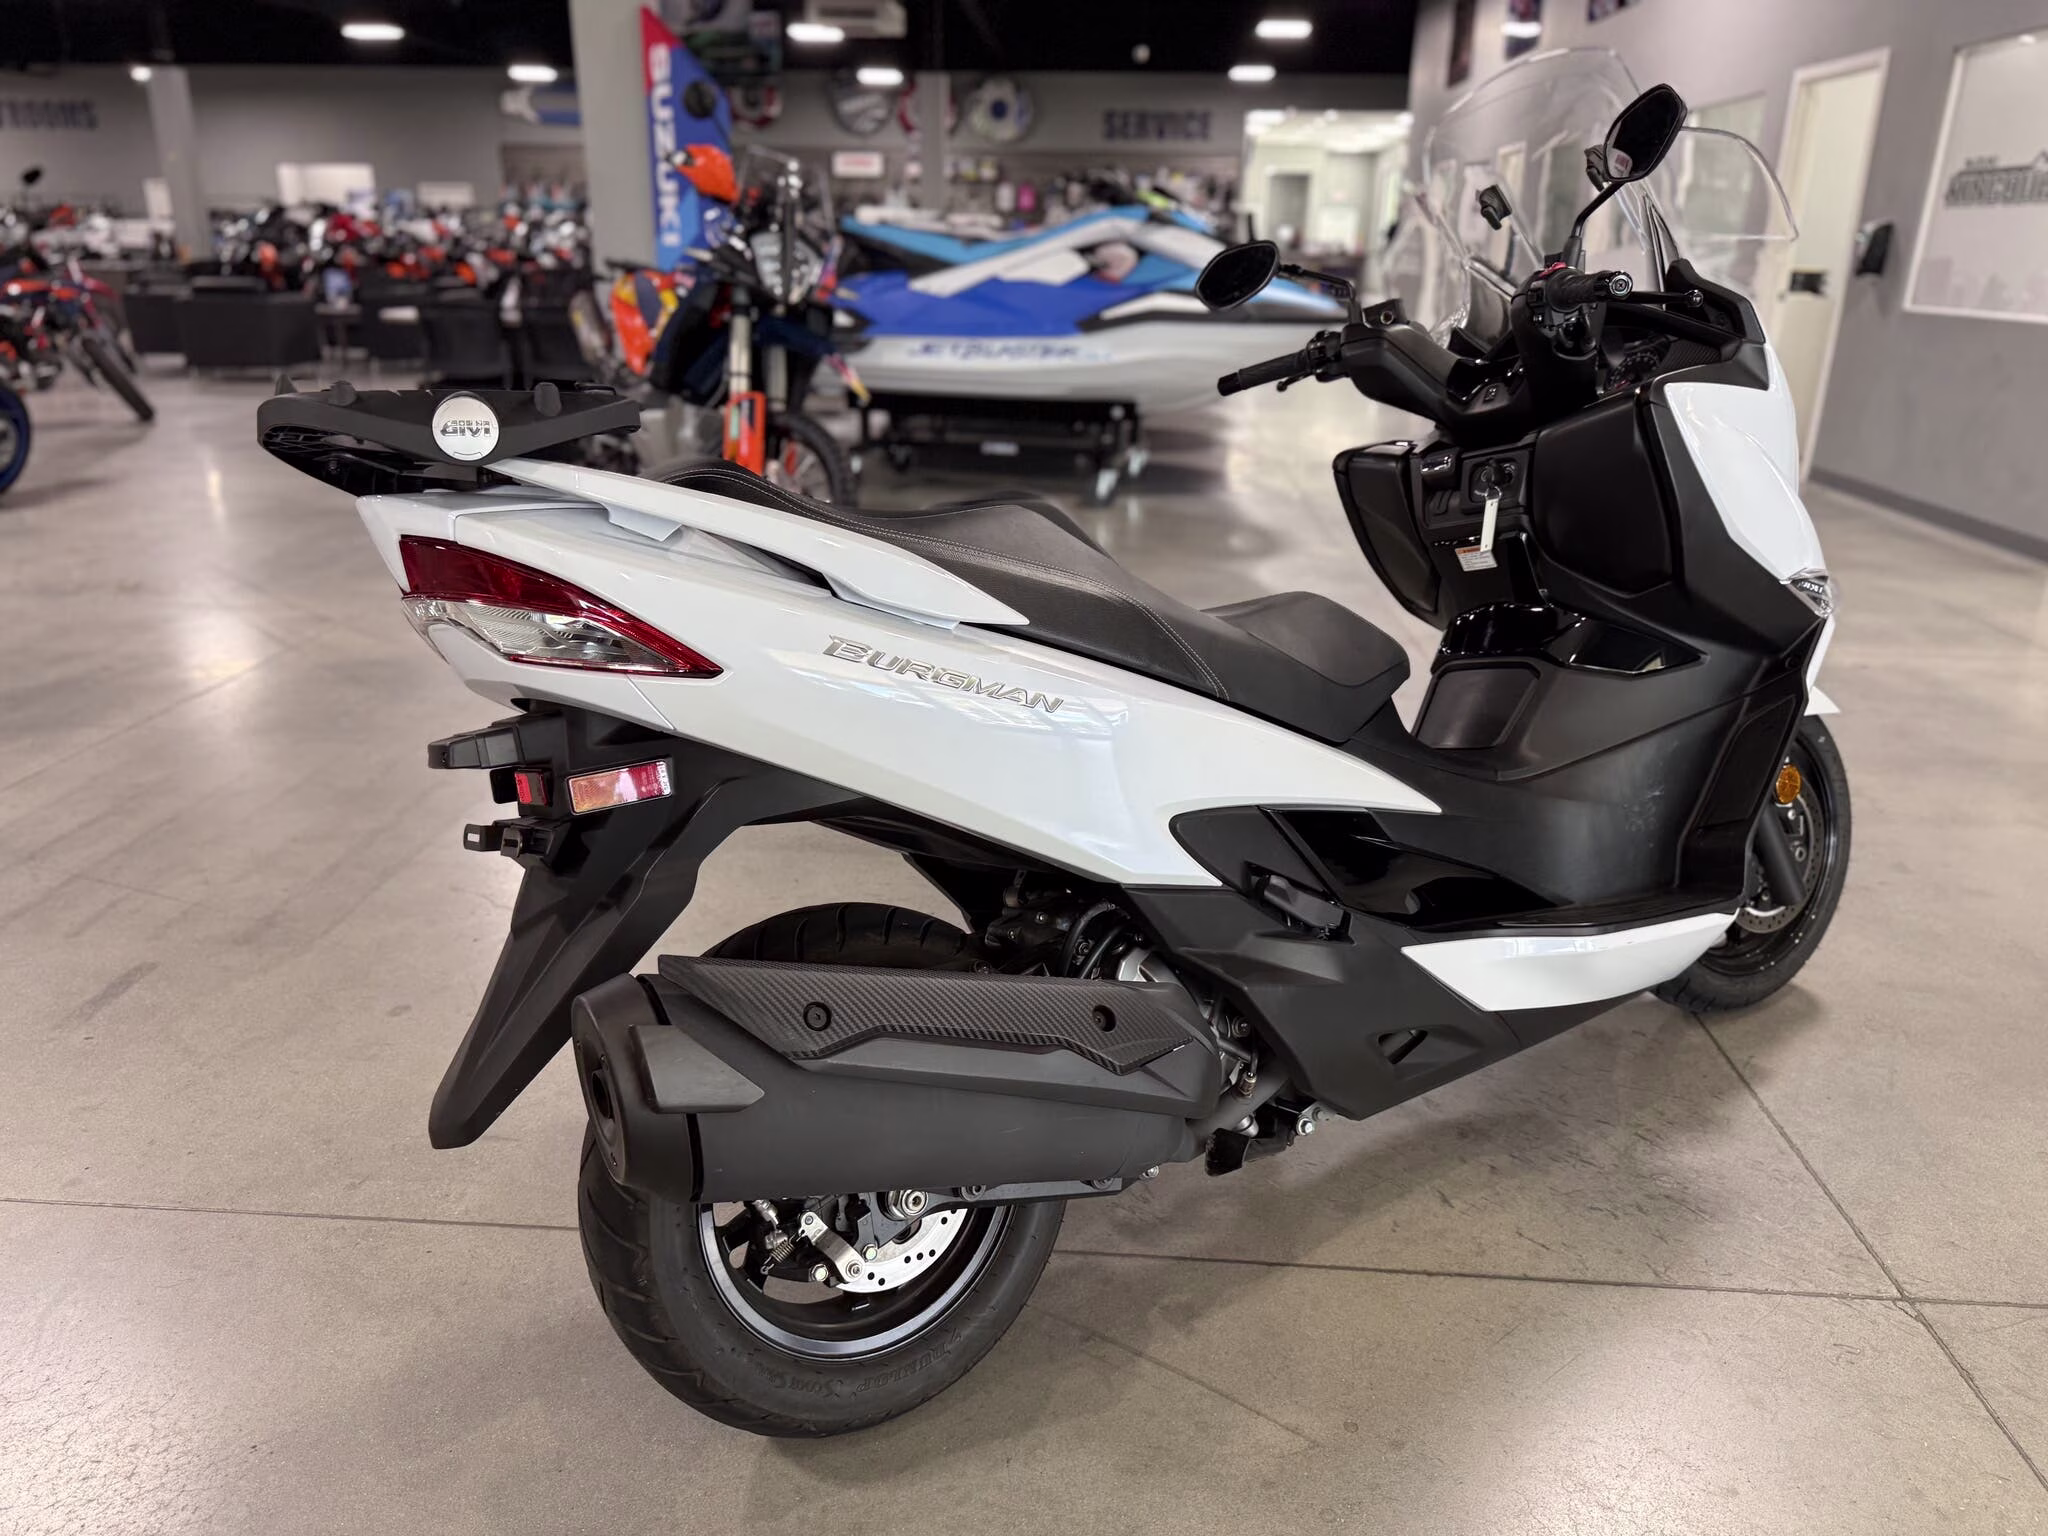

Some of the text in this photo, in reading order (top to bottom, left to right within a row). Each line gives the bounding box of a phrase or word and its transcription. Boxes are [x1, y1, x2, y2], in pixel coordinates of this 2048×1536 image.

[649, 44, 682, 247] SUZUKI
[1104, 109, 1211, 140] SERVICE
[440, 420, 492, 437] GIVI
[822, 634, 1065, 714] BURGMAN
